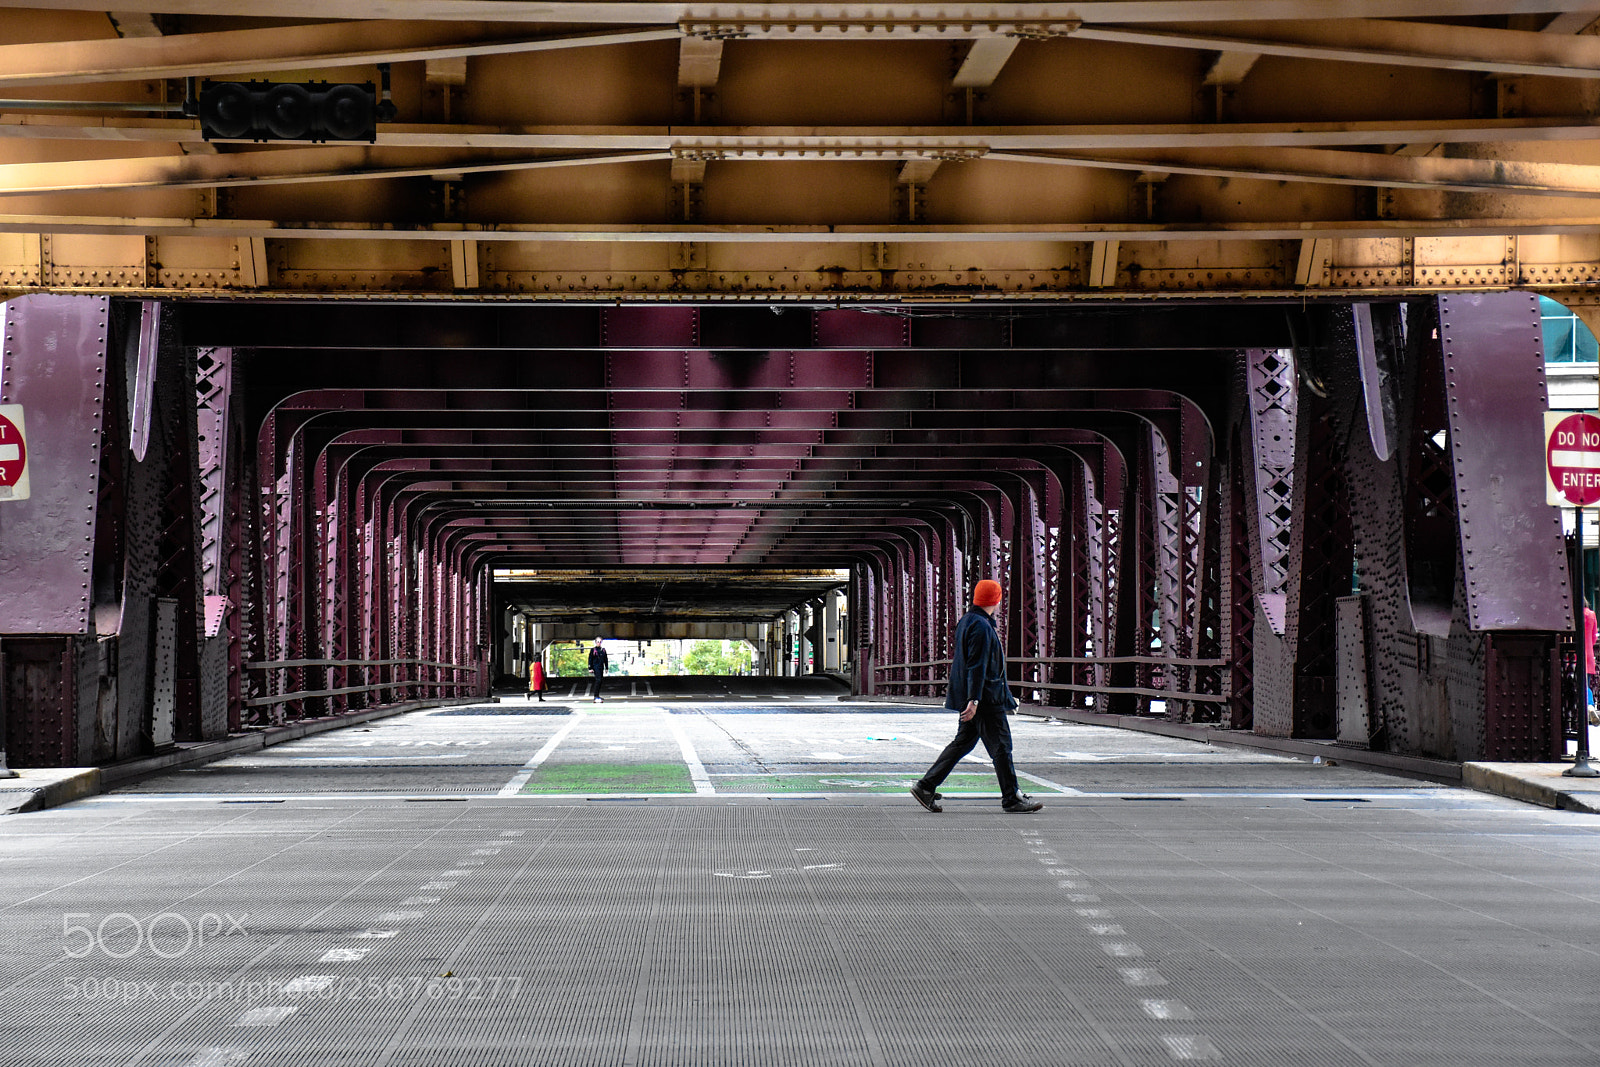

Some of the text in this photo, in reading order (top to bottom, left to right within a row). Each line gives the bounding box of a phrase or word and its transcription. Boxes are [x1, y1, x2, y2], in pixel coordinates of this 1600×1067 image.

[1558, 431, 1600, 447] DO NO
[1562, 472, 1600, 488] ENTER
